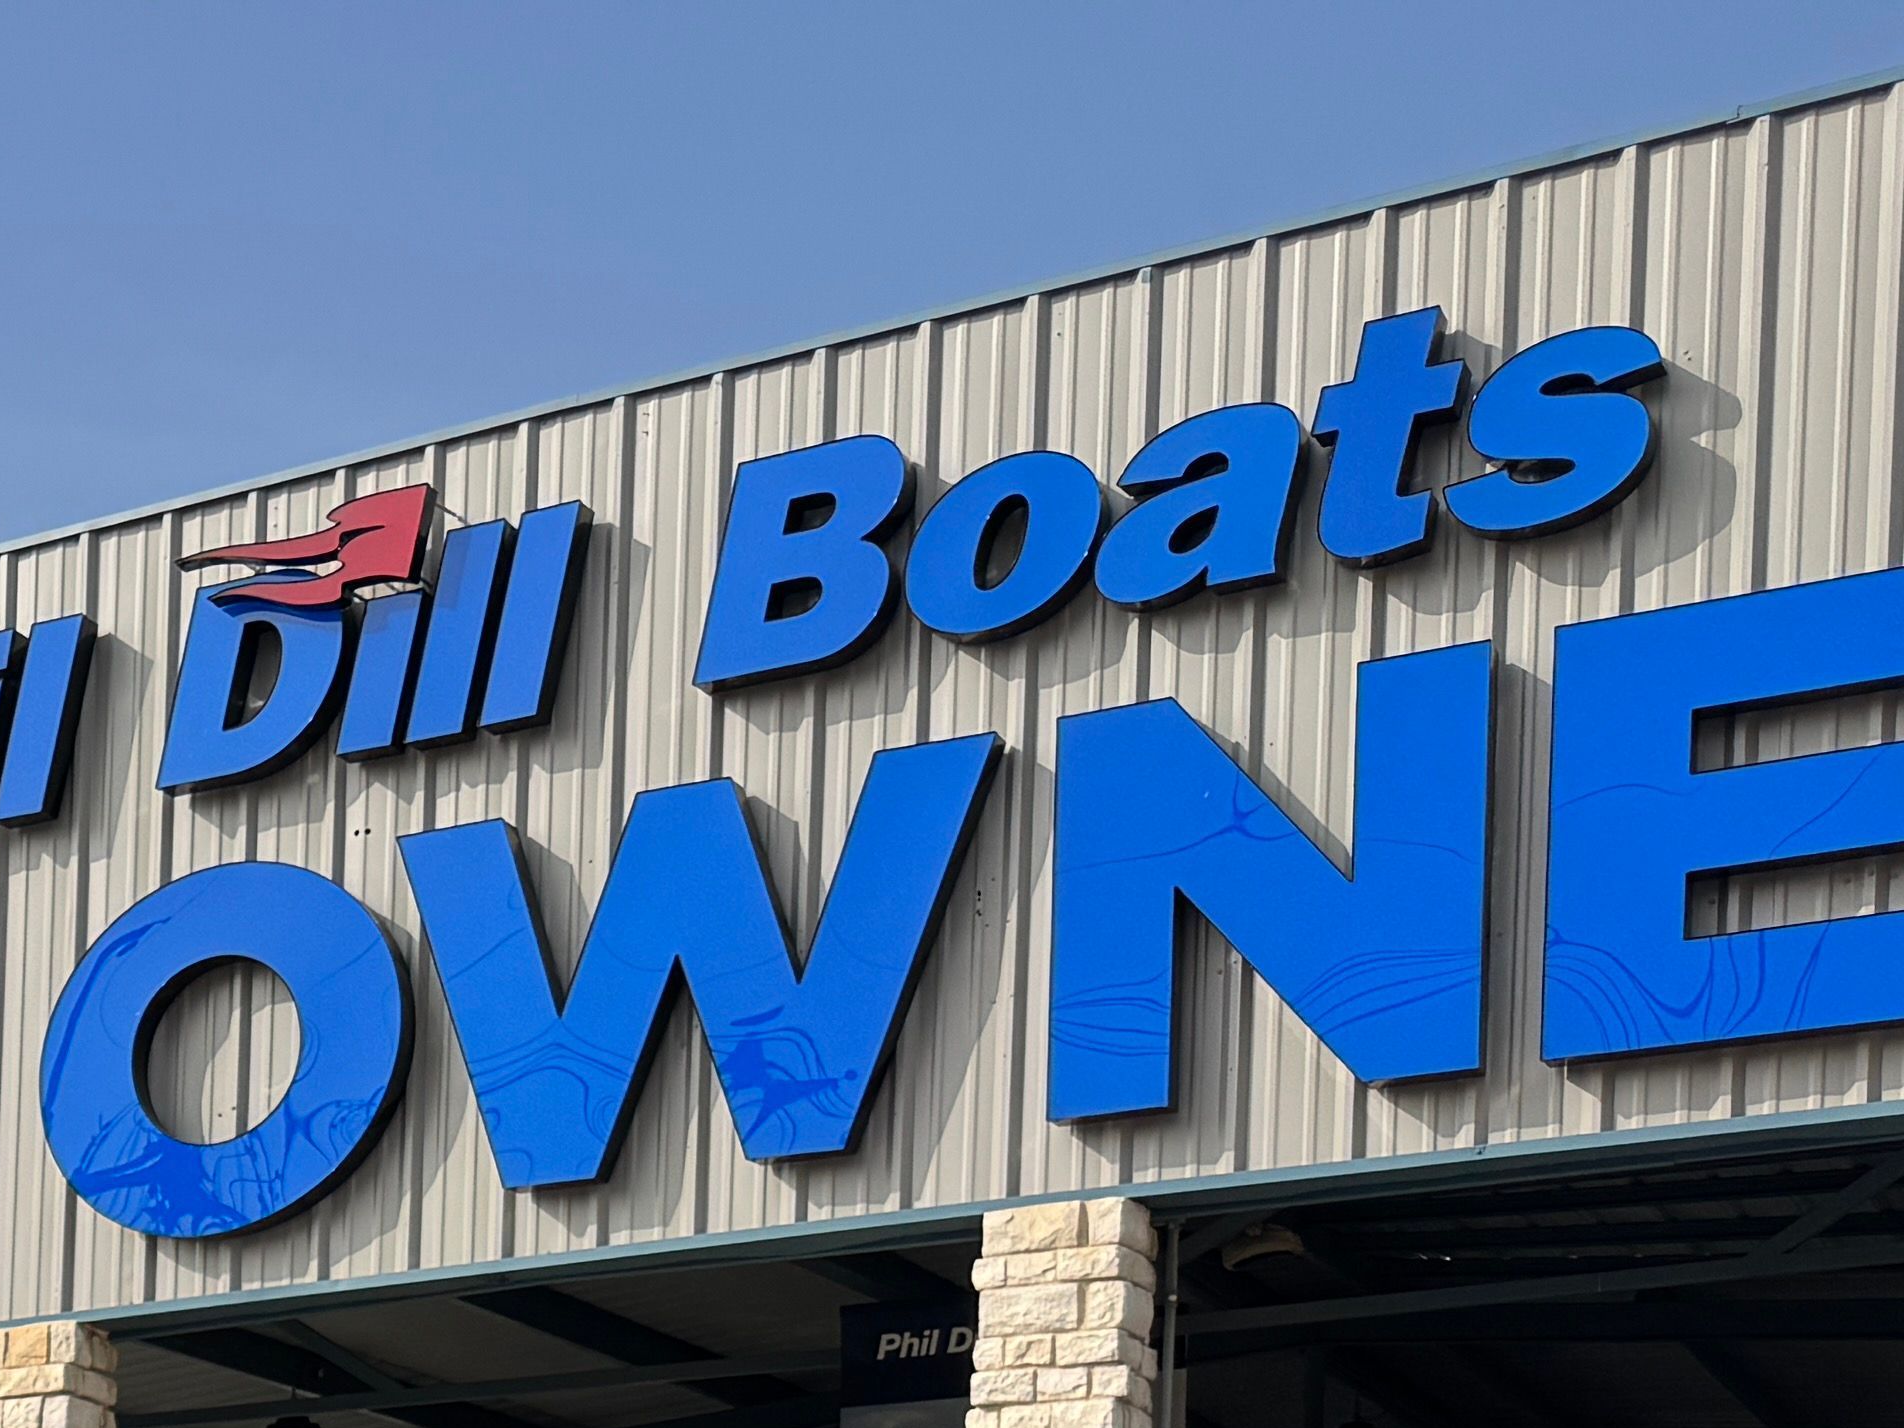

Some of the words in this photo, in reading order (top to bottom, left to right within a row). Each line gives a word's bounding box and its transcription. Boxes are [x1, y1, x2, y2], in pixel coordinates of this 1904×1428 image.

[155, 498, 593, 796] Dill
[691, 304, 1670, 694] Boats
[876, 1328, 941, 1361] Phil
